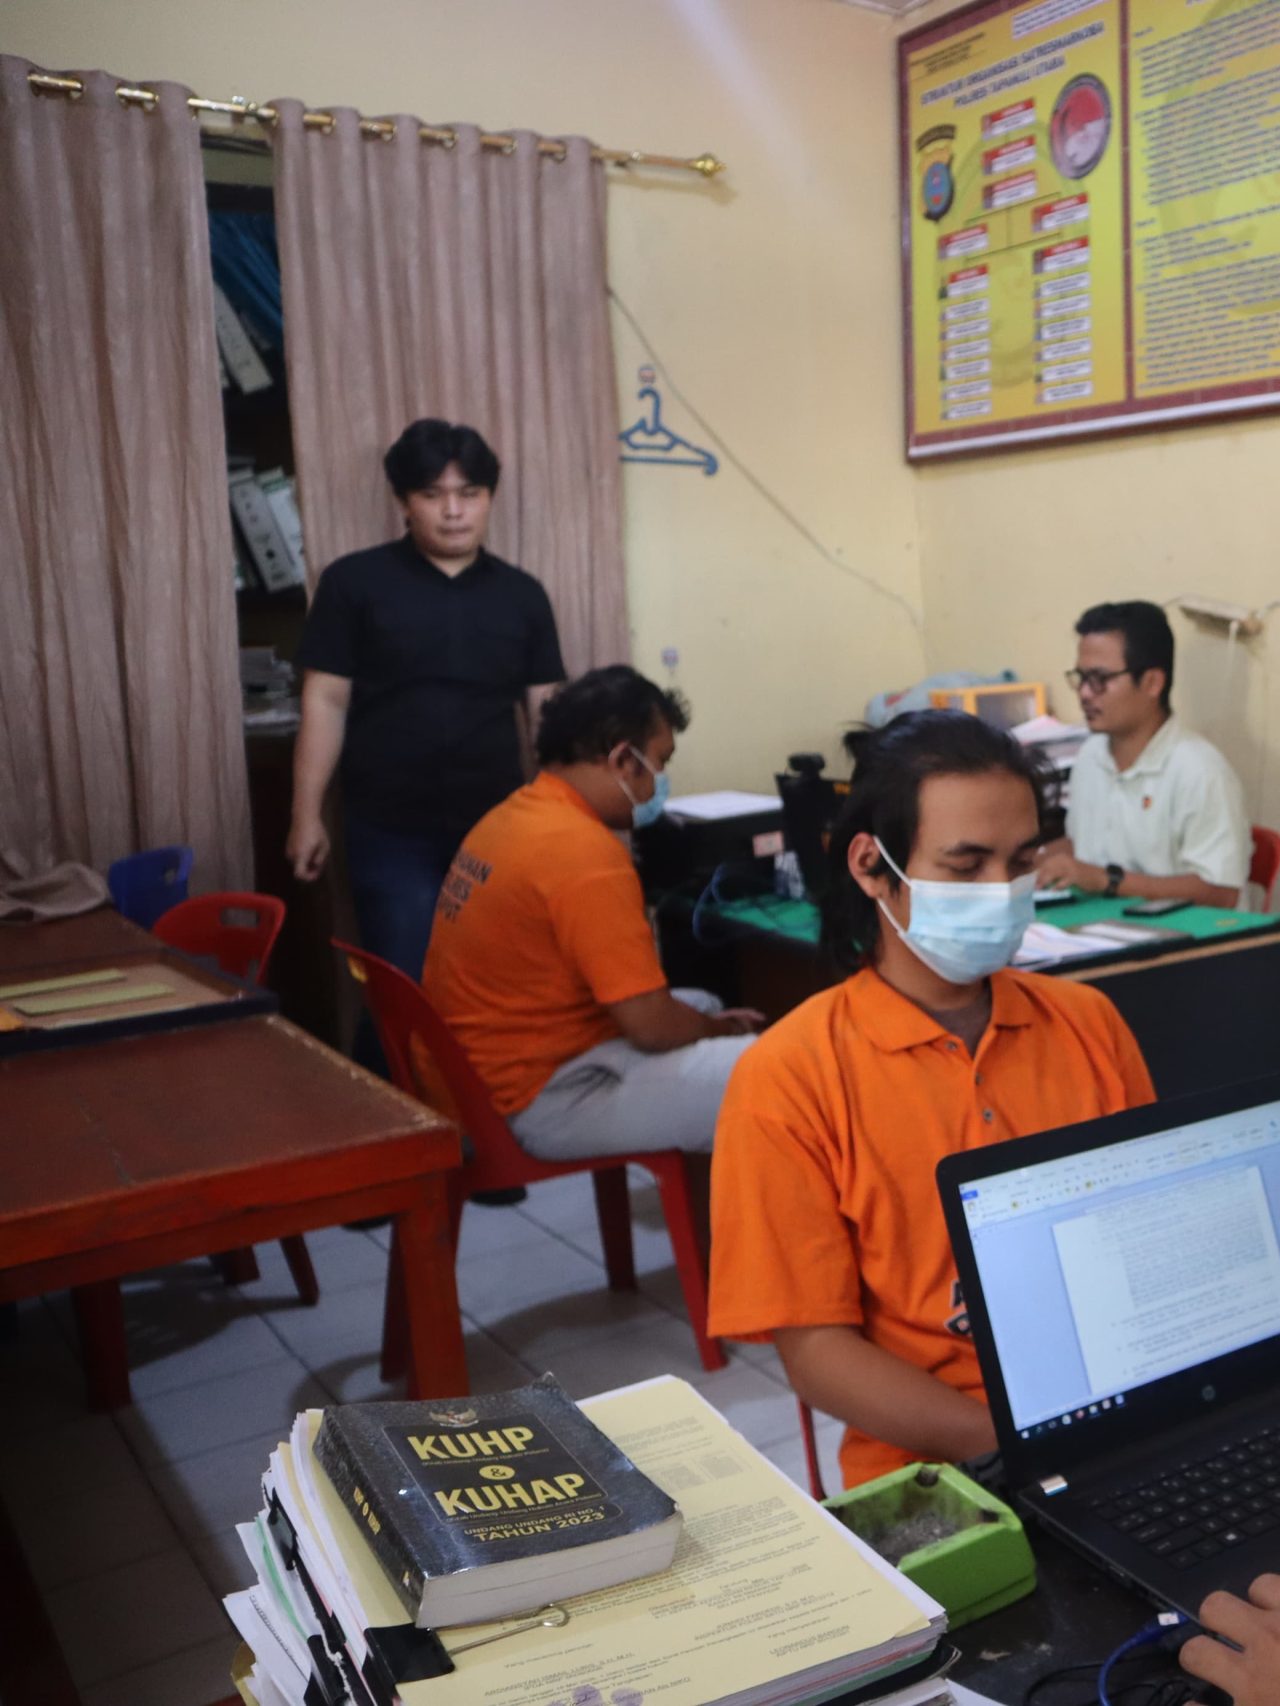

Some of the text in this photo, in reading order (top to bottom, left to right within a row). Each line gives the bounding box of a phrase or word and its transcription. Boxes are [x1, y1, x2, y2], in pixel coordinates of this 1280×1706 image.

[407, 1426, 534, 1460] KUHP
[434, 1473, 585, 1516] KUHAP
[464, 1523, 513, 1535] UNDANG
[515, 1515, 562, 1528] UNDANG
[564, 1511, 576, 1520] RI
[473, 1511, 605, 1542] TAHUN 2023
